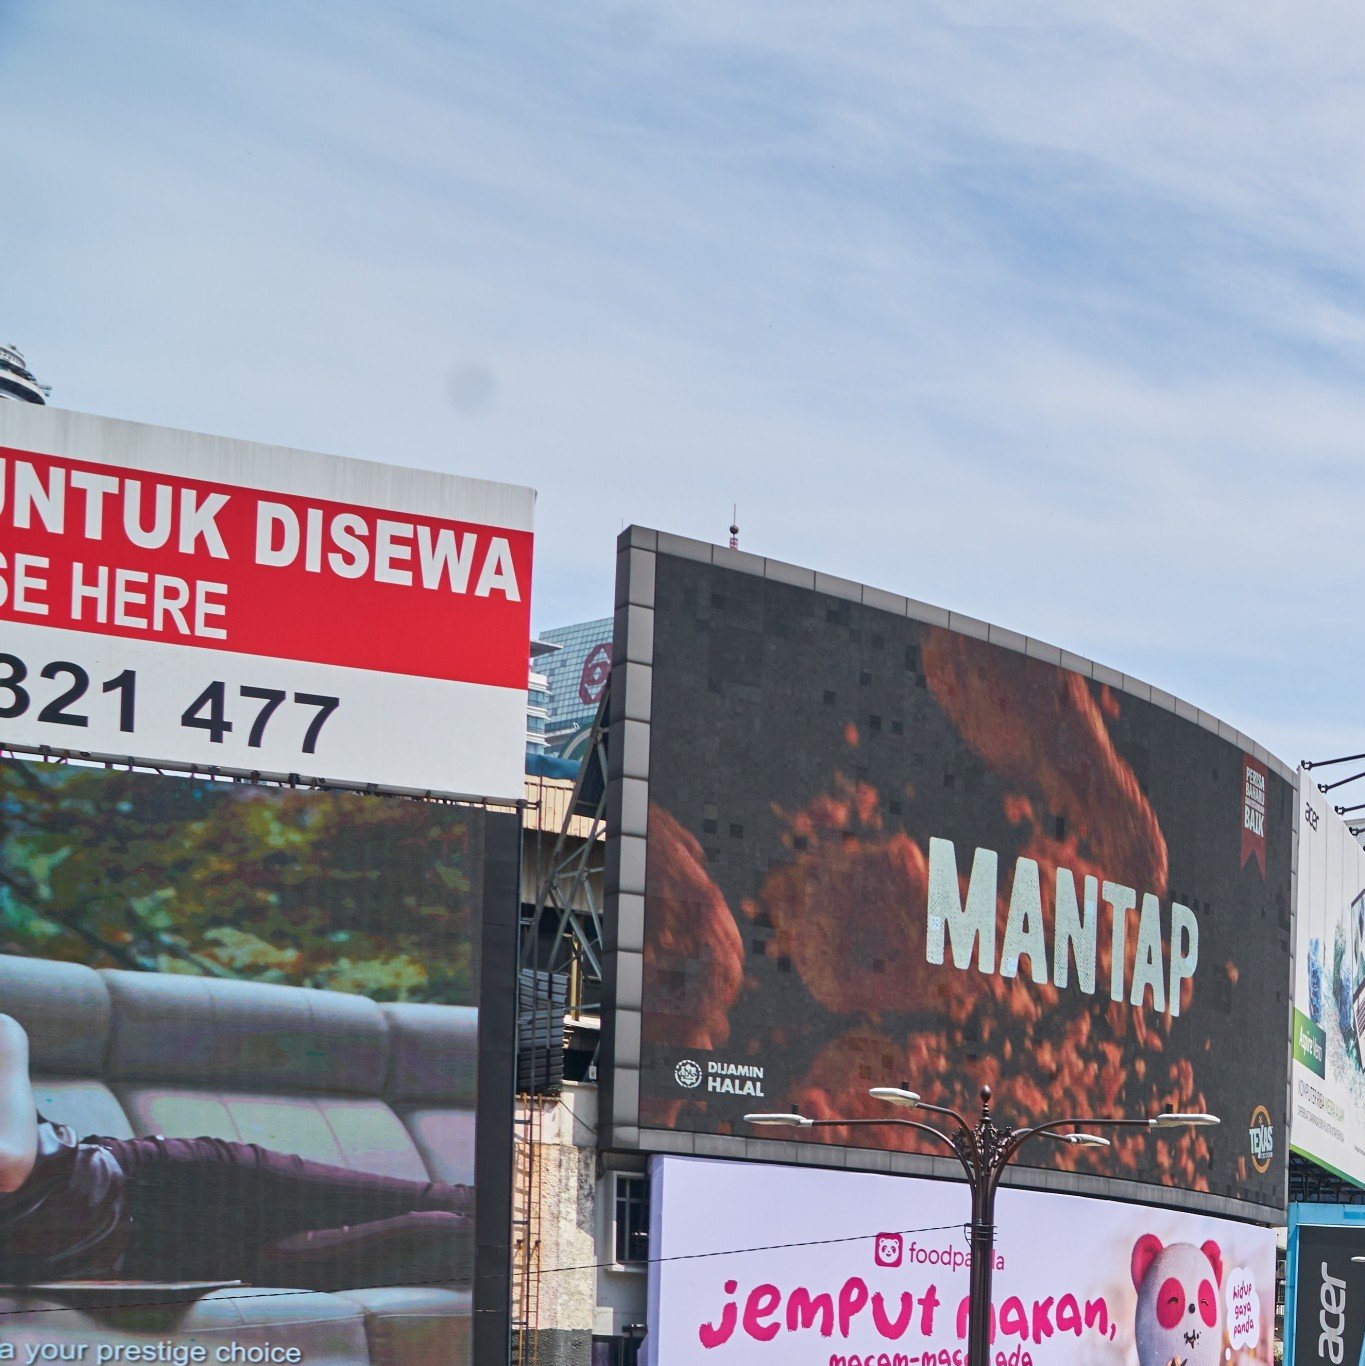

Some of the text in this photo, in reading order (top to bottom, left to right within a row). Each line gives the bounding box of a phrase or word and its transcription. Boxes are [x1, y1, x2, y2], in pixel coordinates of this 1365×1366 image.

[0, 457, 521, 602] NTUK DISEWA
[71, 561, 229, 640] HERE
[181, 680, 340, 754] 477
[1244, 804, 1264, 838] BAIK
[1304, 801, 1320, 833] acer
[925, 836, 1200, 1018] MANTAP
[707, 1060, 765, 1080] DIJAMIN
[707, 1077, 765, 1098] HALAL
[1249, 1125, 1273, 1157] TEXAS
[908, 1241, 1005, 1271] foodpaa
[1232, 1280, 1252, 1300] hidup
[1233, 1314, 1254, 1339] panda
[1234, 1301, 1252, 1320] gaya
[1318, 1261, 1347, 1366] acer
[25, 1342, 89, 1366] your
[215, 1340, 302, 1364] choice
